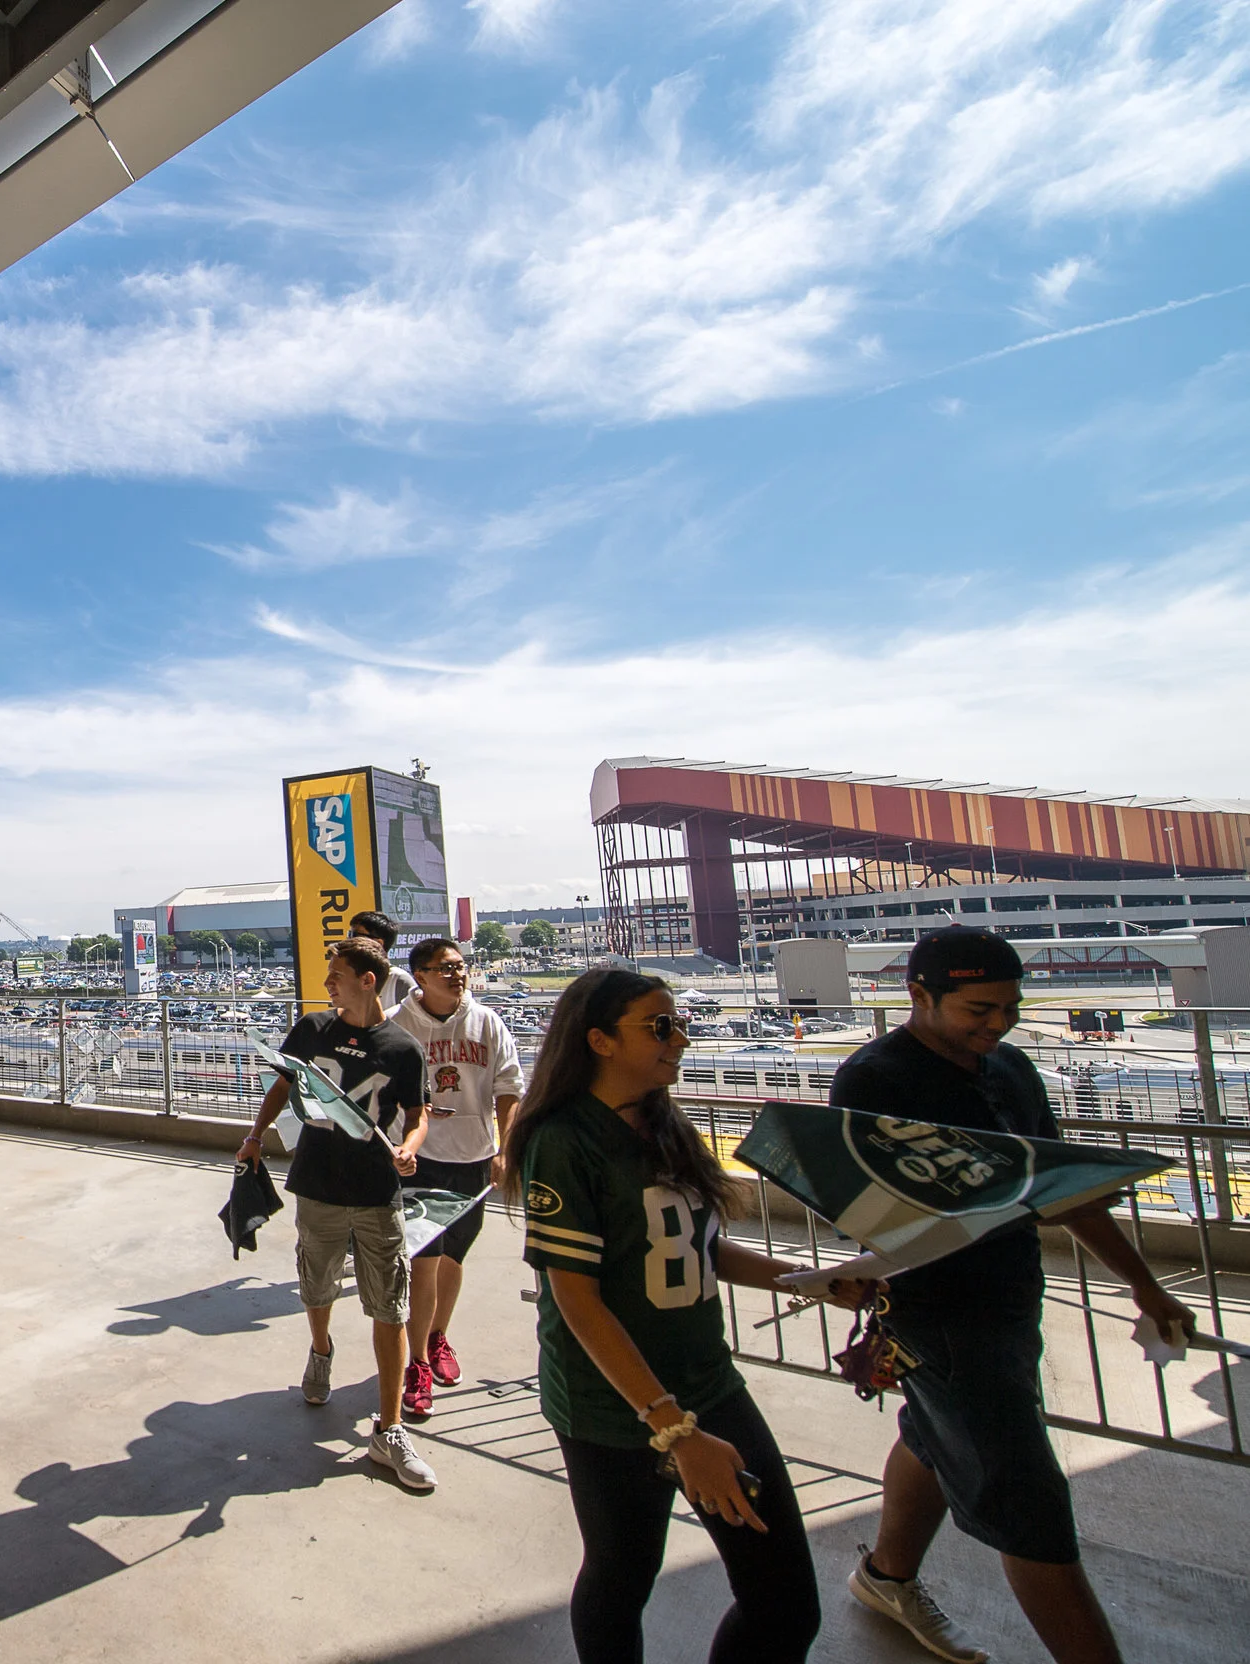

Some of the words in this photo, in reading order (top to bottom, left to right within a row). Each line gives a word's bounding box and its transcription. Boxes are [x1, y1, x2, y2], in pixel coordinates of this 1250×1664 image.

[313, 796, 347, 866] SAP
[396, 933, 408, 945] BE
[334, 1046, 367, 1058] JETS
[427, 1039, 488, 1068] RYLAND
[876, 1115, 994, 1187] JETS
